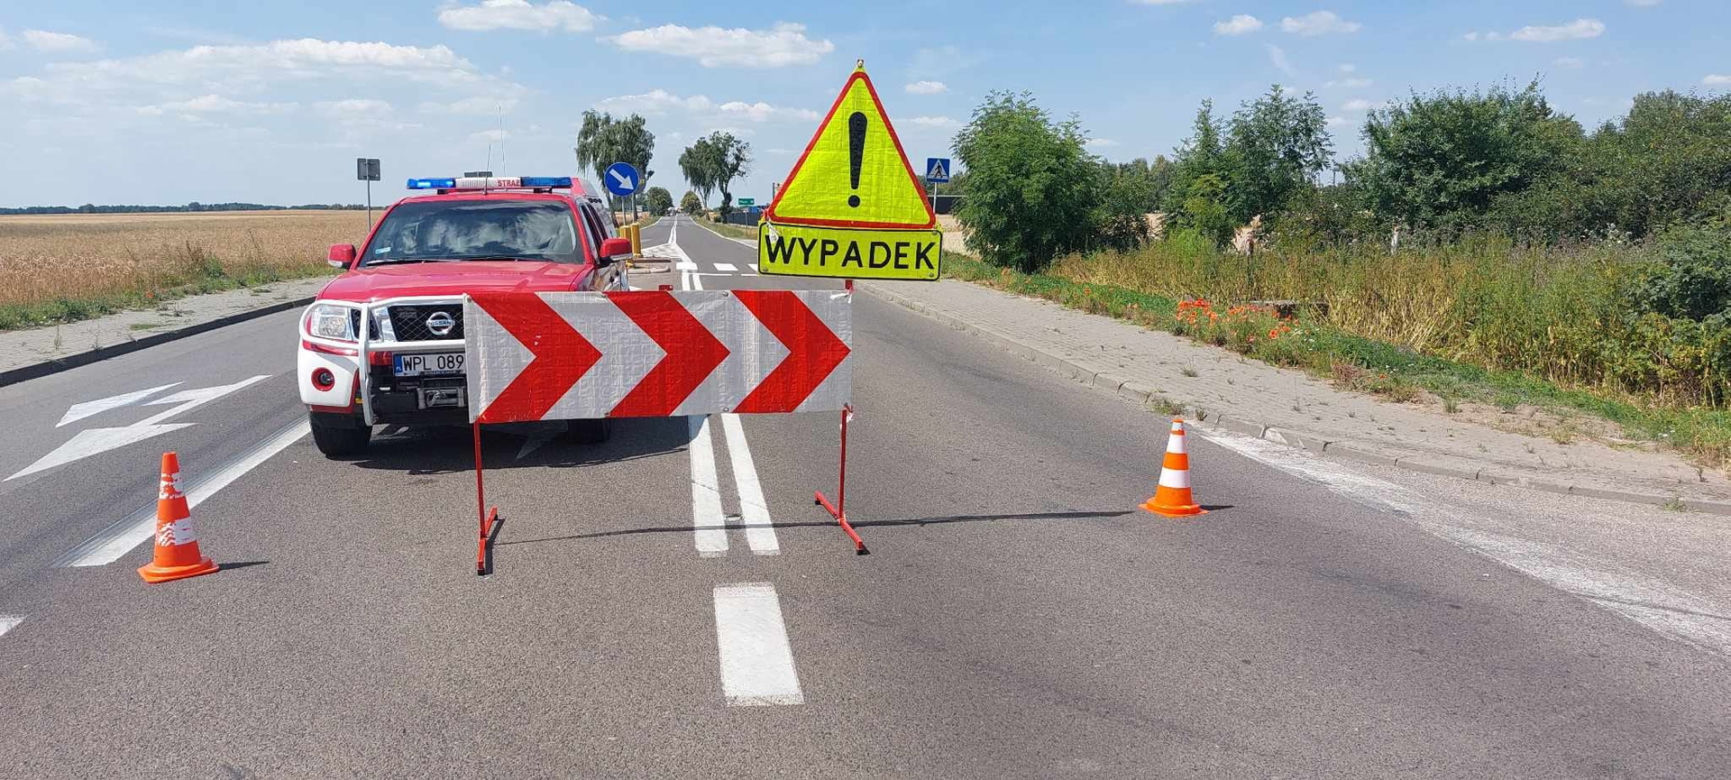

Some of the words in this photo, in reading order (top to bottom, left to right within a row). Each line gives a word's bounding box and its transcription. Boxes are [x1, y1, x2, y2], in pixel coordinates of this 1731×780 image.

[765, 235, 936, 270] WYPADEK
[403, 356, 431, 371] WPL
[437, 355, 464, 370] 089
